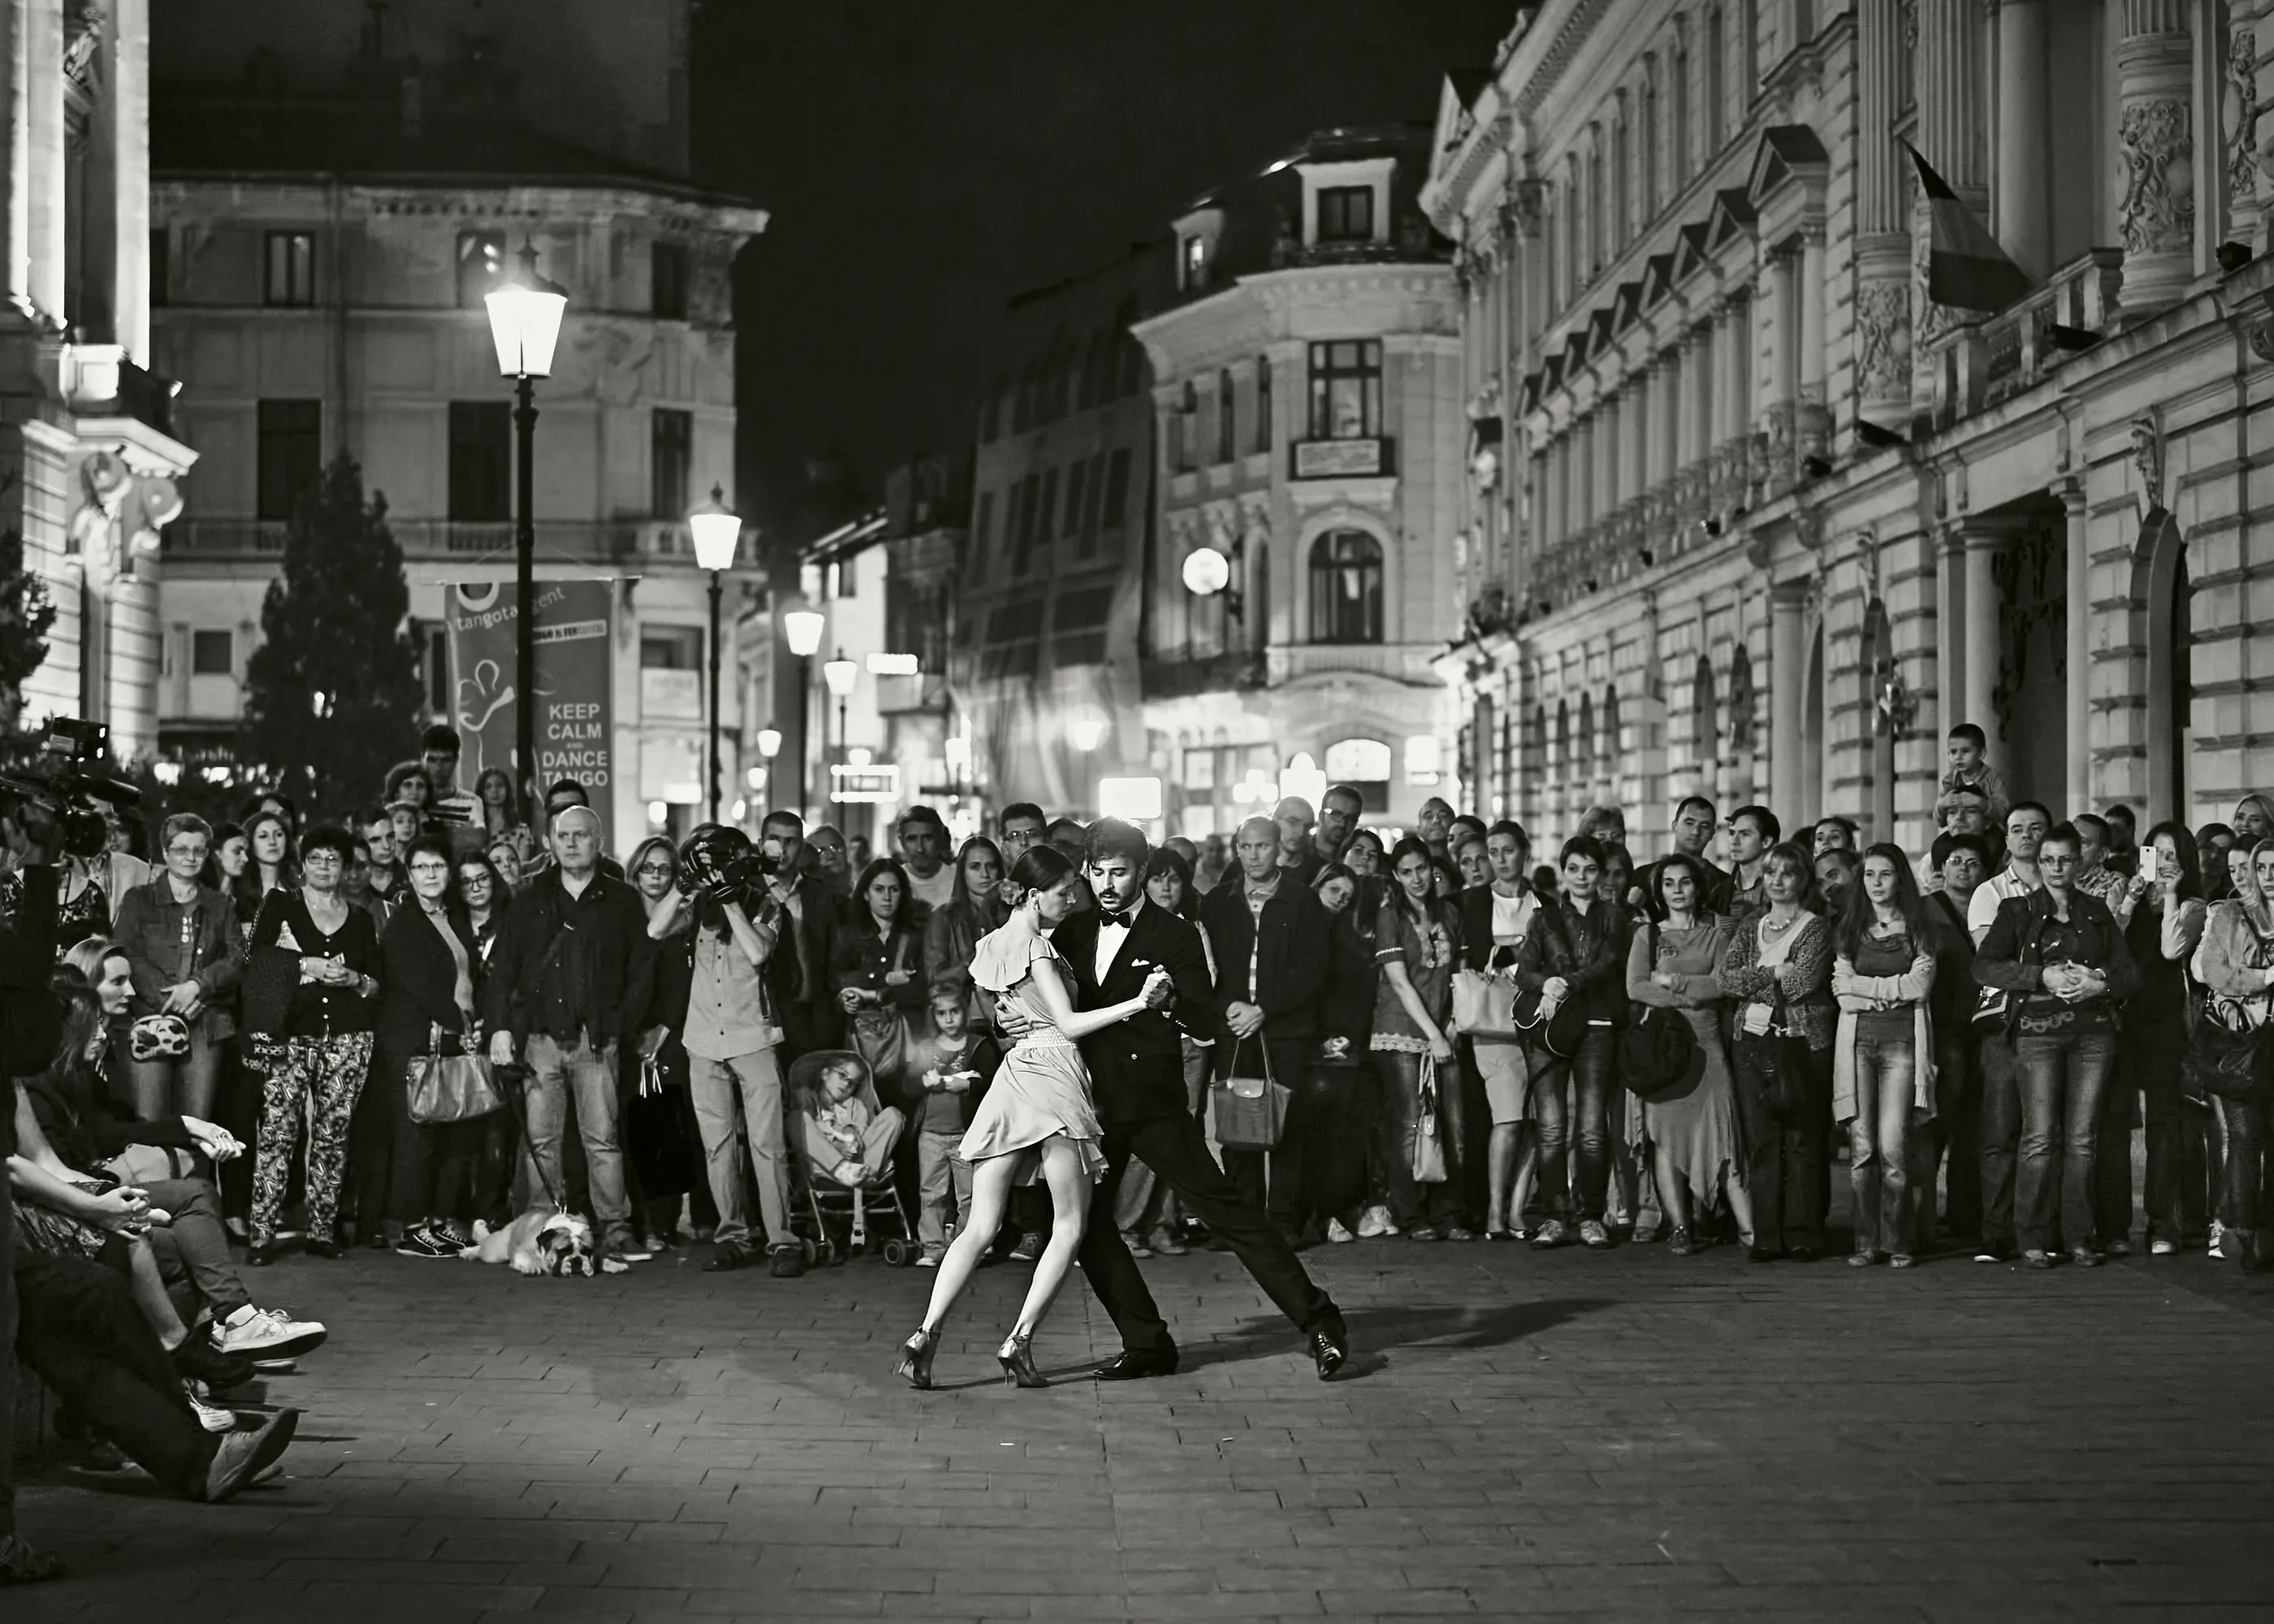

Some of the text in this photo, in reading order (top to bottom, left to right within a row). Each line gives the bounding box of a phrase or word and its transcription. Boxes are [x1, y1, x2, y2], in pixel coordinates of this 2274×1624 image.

[549, 702, 600, 719] KEEP
[547, 723, 602, 740] CALM
[543, 750, 608, 768] DANCE
